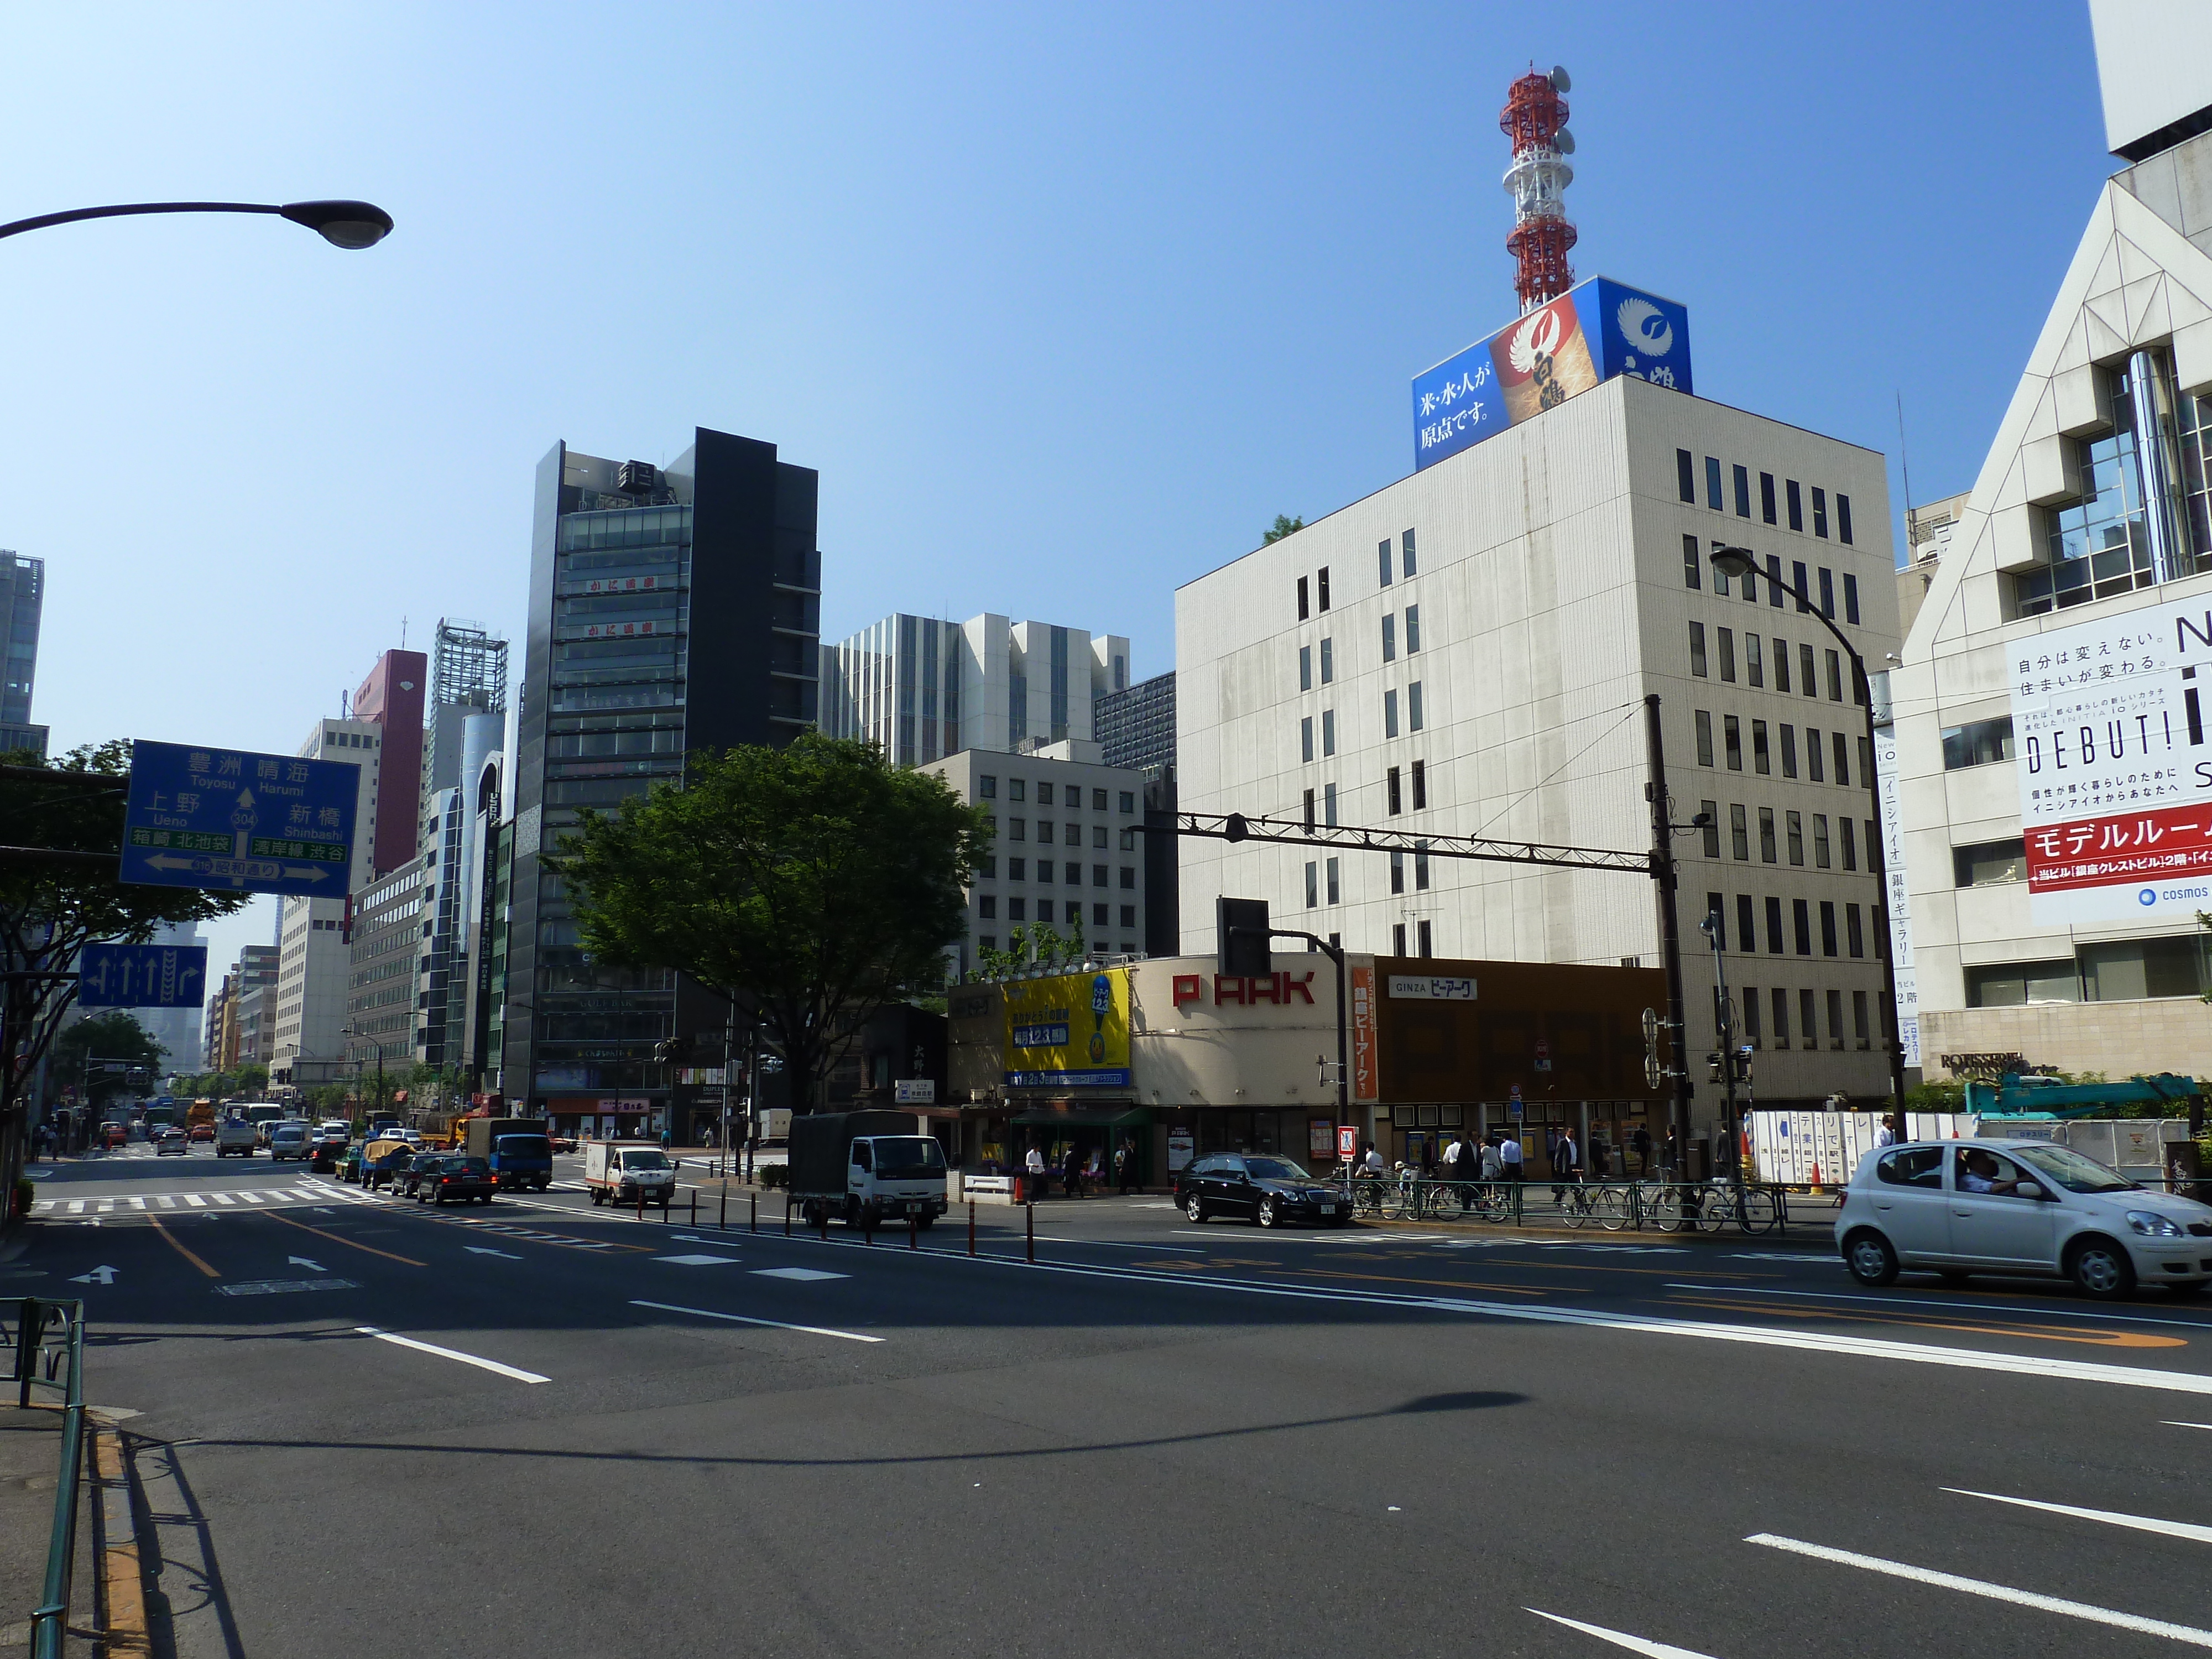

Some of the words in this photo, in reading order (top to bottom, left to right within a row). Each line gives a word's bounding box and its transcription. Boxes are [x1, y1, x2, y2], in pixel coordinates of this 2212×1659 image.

[1421, 402, 1488, 450] 原点です。
[2019, 633, 2163, 675] 自分は変えない。
[2020, 655, 2166, 696] 住まいが変わる。
[2131, 697, 2166, 711] シリーズ
[2026, 710, 2172, 774] DEBUT!
[188, 751, 242, 777] 豊洲
[257, 759, 310, 784] 晴海
[190, 774, 236, 790] Toyosu
[259, 782, 304, 797] Harumi
[2032, 768, 2177, 800] 個性が輝く暮らしのために
[144, 790, 200, 814] 上野
[2033, 784, 2178, 814] イニシアイオからあなたへ
[153, 813, 187, 827] Ueno
[234, 813, 254, 825] 304
[289, 803, 341, 827] 新橋
[177, 833, 229, 852] 北池袋
[284, 826, 343, 842] Shinbashi
[254, 839, 304, 857] 湾岸線
[310, 844, 346, 862] 渋谷
[215, 859, 275, 877] 昭和通り
[2162, 887, 2208, 900] cosmos
[1396, 983, 1426, 992] GINZA
[1431, 979, 1470, 998] ピーアーク
